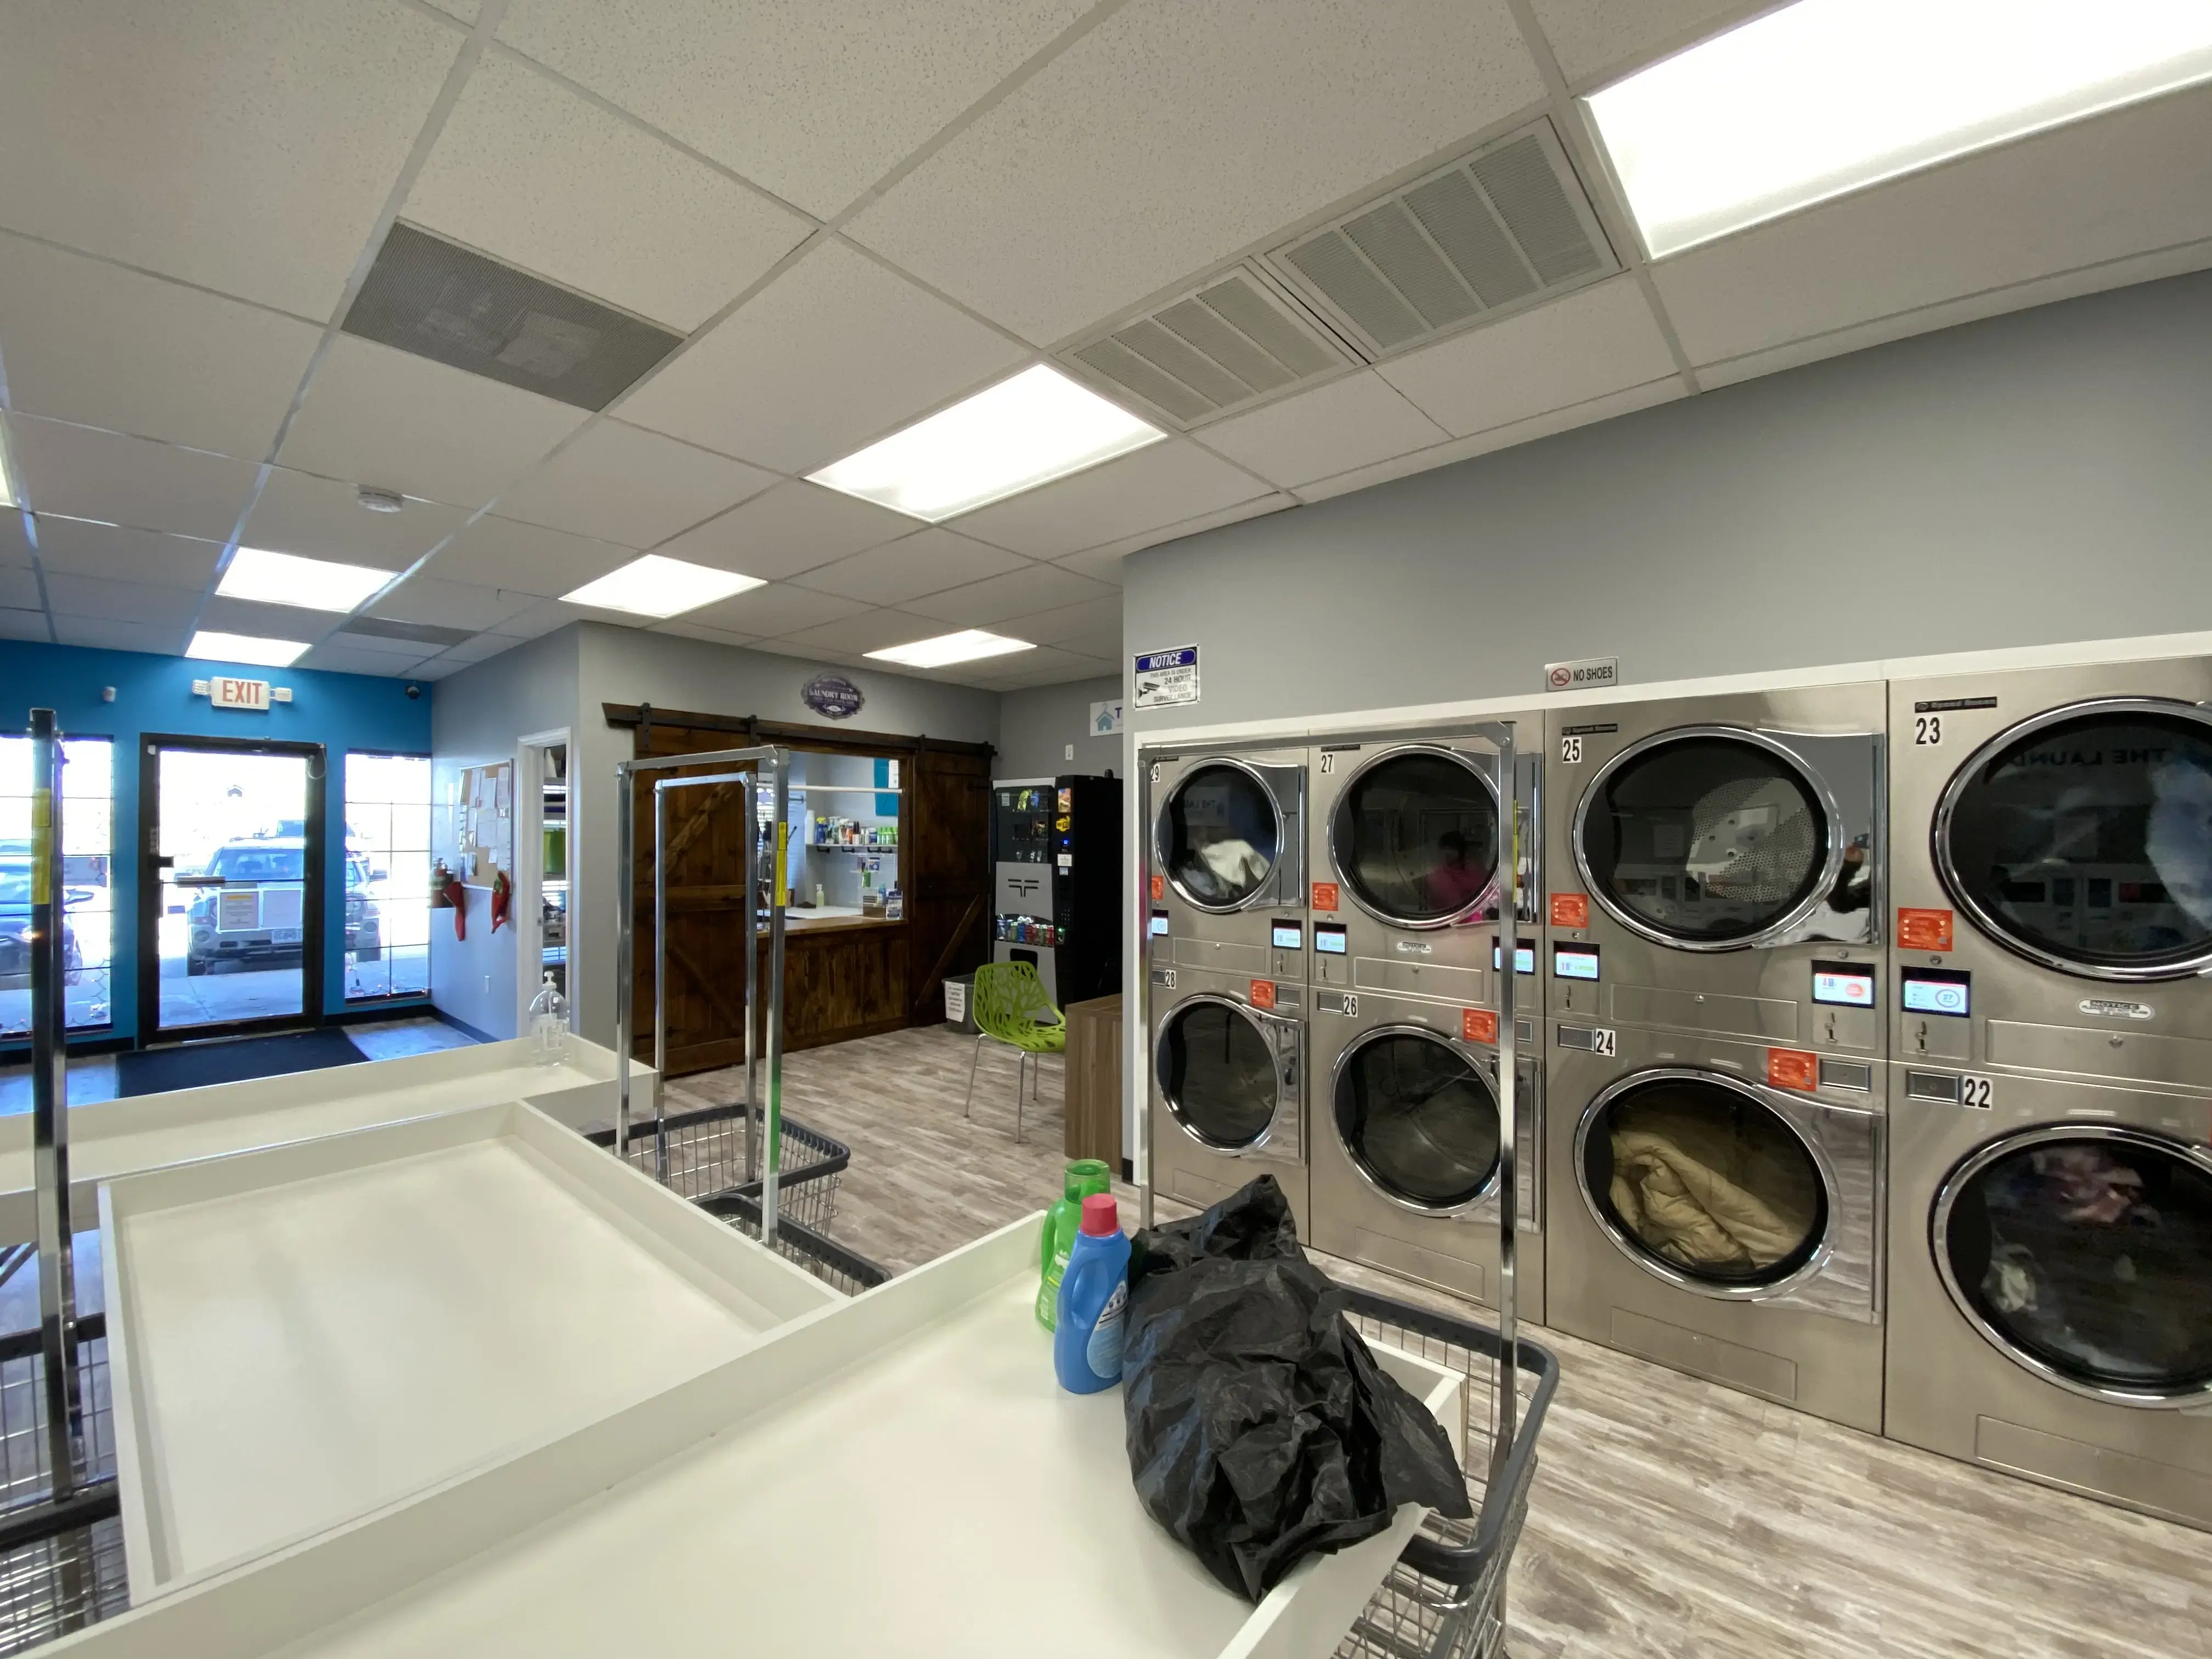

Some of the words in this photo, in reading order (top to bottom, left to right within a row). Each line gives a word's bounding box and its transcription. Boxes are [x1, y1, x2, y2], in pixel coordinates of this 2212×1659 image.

[1149, 652, 1182, 669] NOTICE
[1174, 674, 1191, 683] HOUR
[1573, 669, 1584, 681] NO
[1587, 666, 1612, 680] SHOES
[222, 680, 262, 704] EXIT
[809, 688, 838, 698] LAUNDRY
[840, 692, 858, 701] ROOM
[1168, 684, 1187, 692] VIDEO
[1153, 692, 1191, 702] SURVEILLANCE
[1915, 716, 1940, 744] 23
[1563, 739, 1580, 761] 25
[1321, 754, 1333, 773] 27
[1150, 765, 1159, 781] 29
[1166, 972, 1175, 988] 28
[1344, 996, 1356, 1015] 26
[1596, 1031, 1613, 1055] 24
[1965, 1079, 1990, 1108] 22
